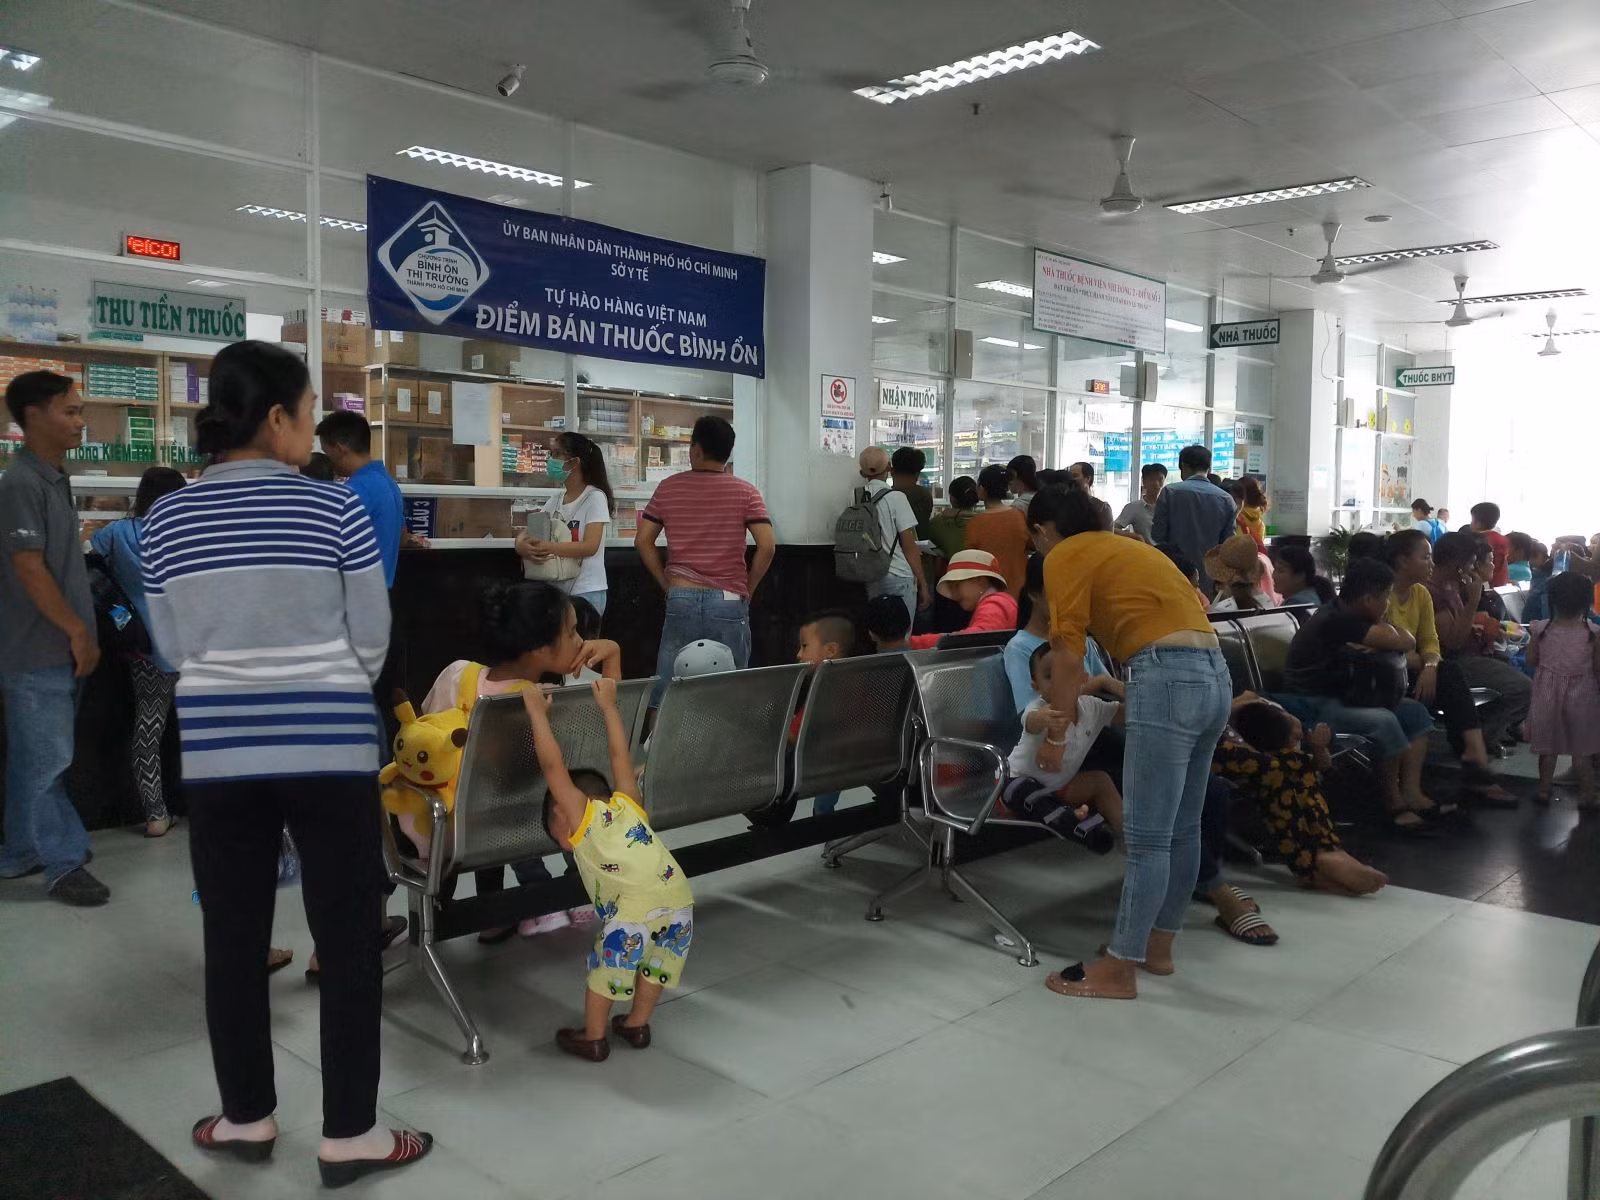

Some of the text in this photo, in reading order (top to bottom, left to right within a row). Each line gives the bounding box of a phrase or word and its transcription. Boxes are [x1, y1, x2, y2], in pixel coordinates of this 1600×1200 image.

[503, 220, 738, 280] ỦY BAN NHÂN DÂN THÀNH PHỐ HỒ CHÍ MINH
[418, 260, 441, 272] BÌNH
[611, 262, 649, 282] SỞ Y TẾ
[407, 269, 469, 286] THỊ TRƯỜNG
[97, 294, 245, 337] THU TIỀN THUỐC
[545, 288, 707, 328] TỰ HÀO HÀNG VIỆT NAM
[476, 301, 758, 366] ĐIỂM BÁN THUỐC BÌNH ỔN
[1219, 322, 1277, 343] NHÀ THUỐC
[1403, 370, 1453, 384] THUỐC BHYT
[883, 385, 935, 409] NHẬN THUỐC
